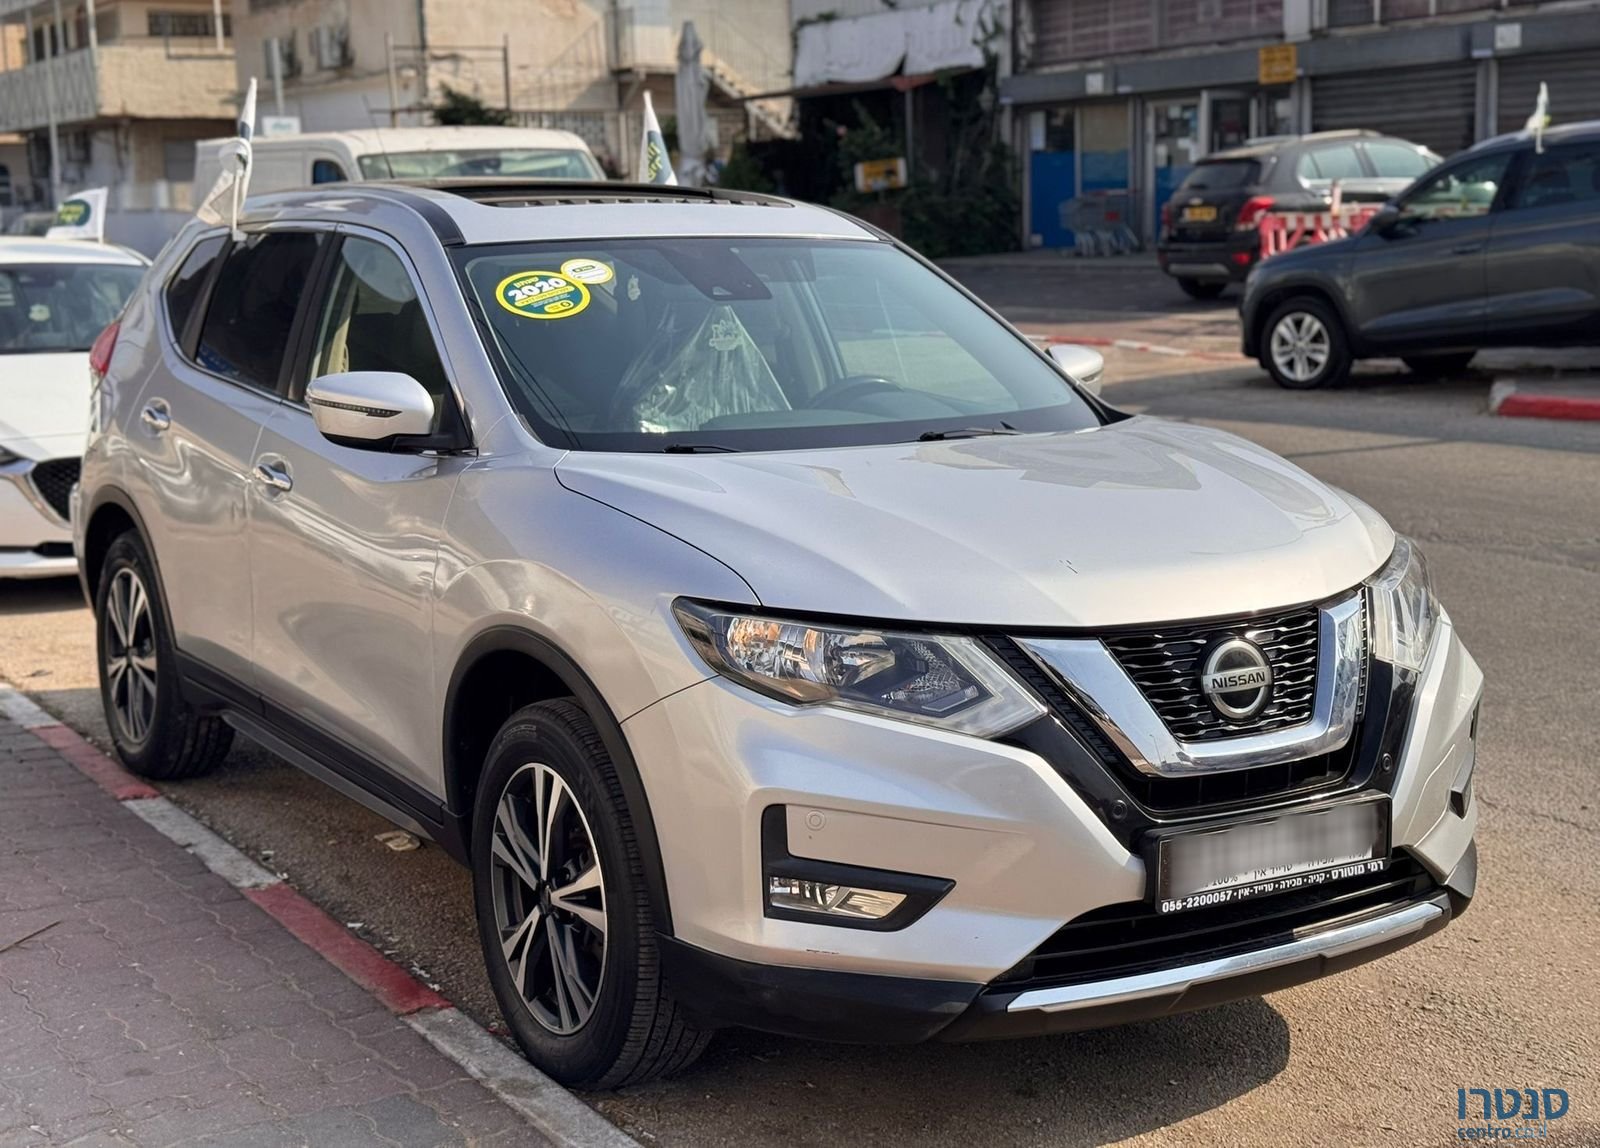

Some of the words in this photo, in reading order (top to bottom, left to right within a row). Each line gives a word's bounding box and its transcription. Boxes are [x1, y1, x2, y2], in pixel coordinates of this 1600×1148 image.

[508, 278, 567, 302] 2020
[1211, 671, 1266, 689] NISSAN
[1331, 864, 1365, 880] מוטורס
[1367, 860, 1384, 872] רמי
[1280, 877, 1303, 889] מכירה
[1308, 872, 1326, 883] קניה
[1238, 882, 1274, 899] טרייד-אין
[1162, 890, 1233, 913] 055-2200057
